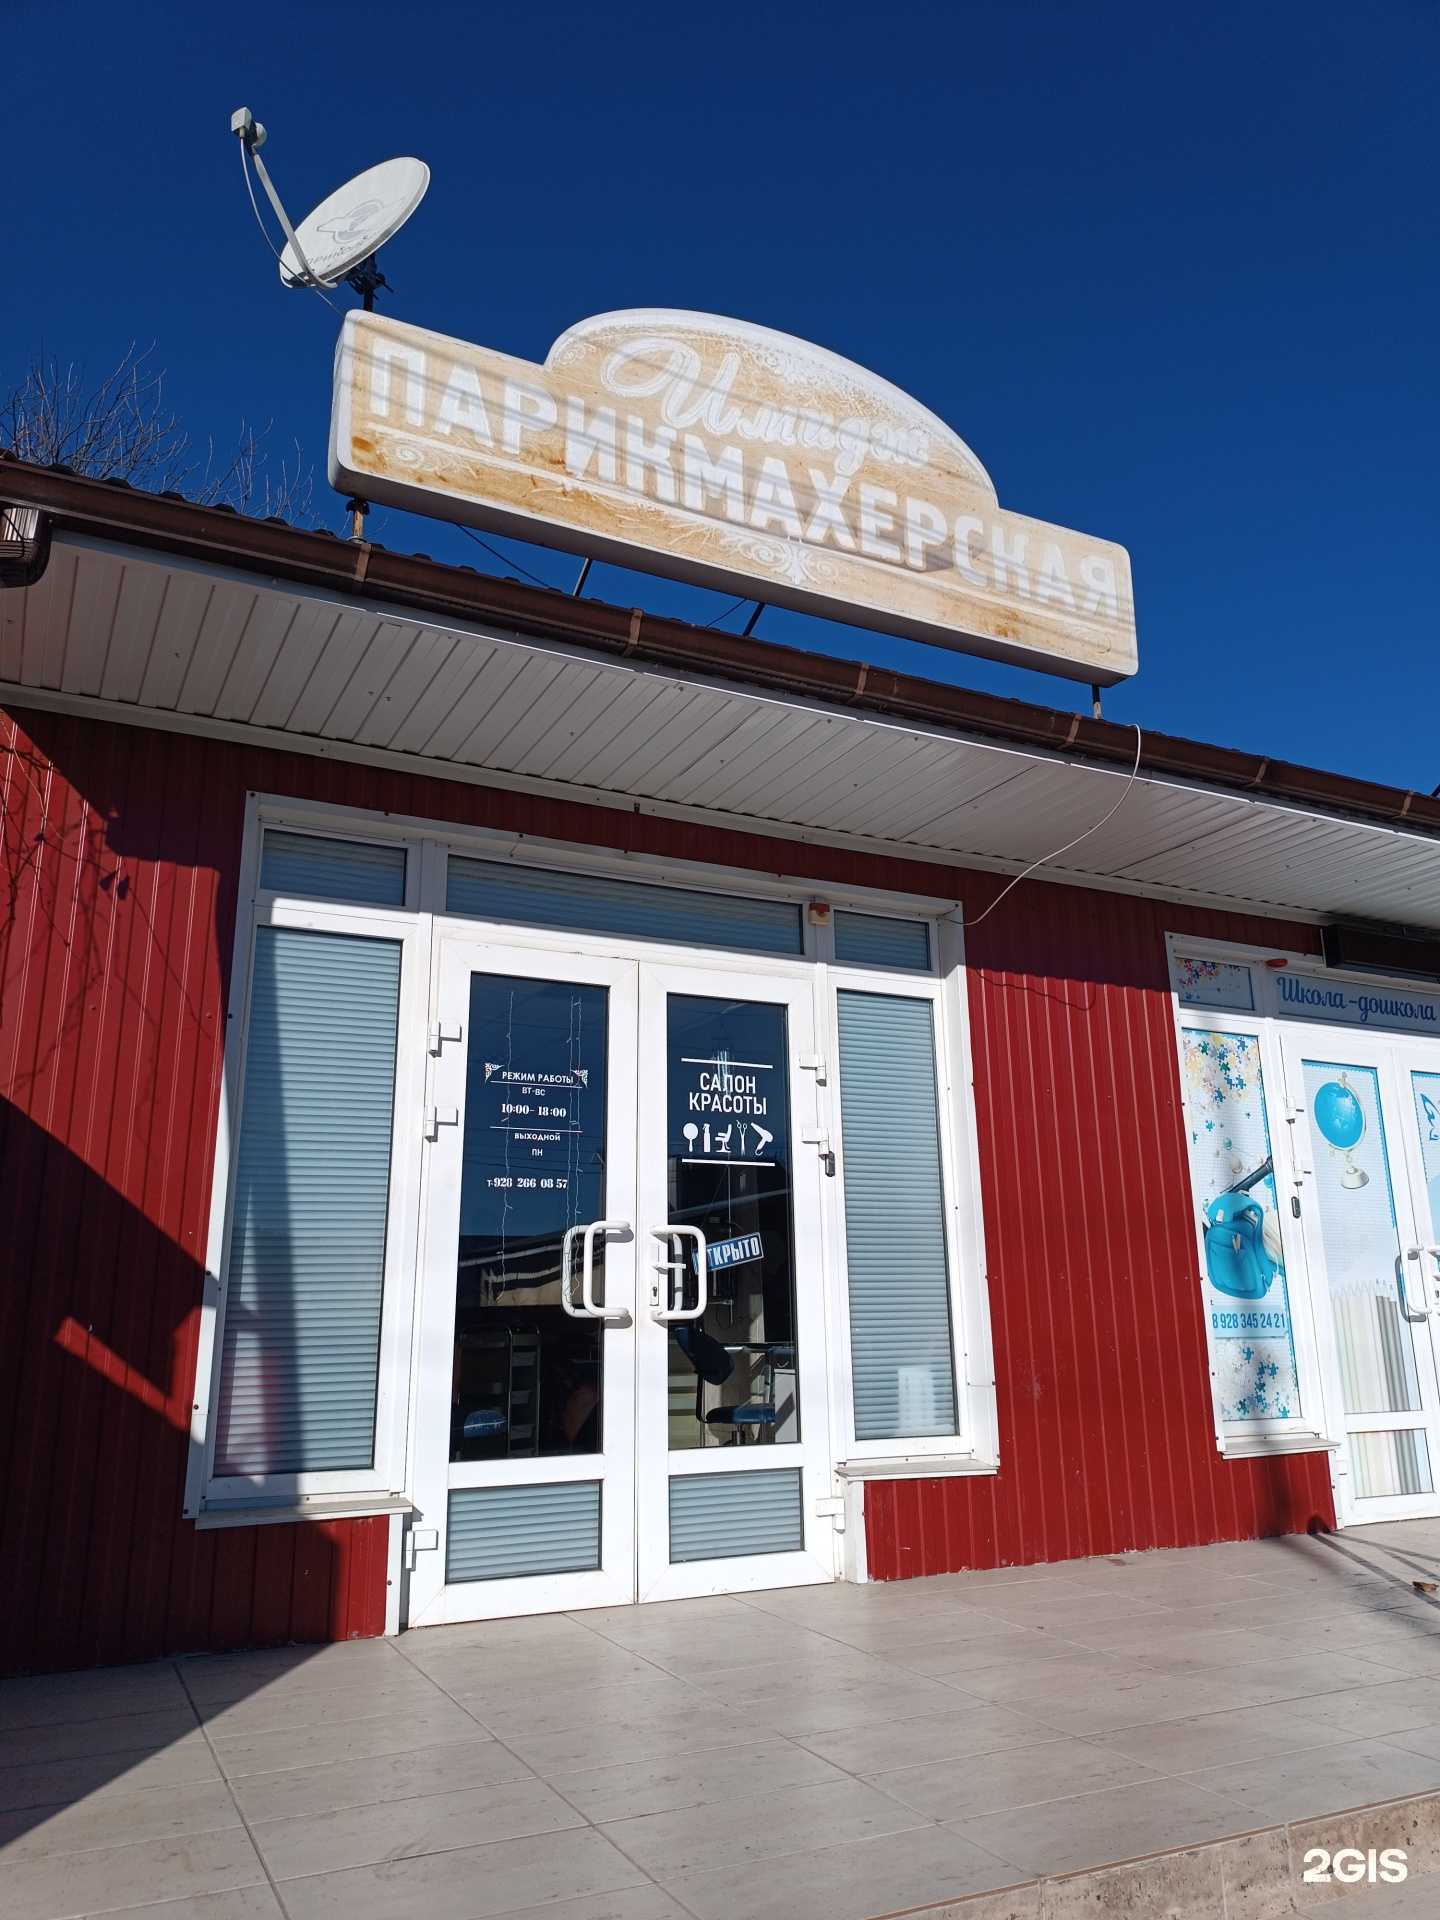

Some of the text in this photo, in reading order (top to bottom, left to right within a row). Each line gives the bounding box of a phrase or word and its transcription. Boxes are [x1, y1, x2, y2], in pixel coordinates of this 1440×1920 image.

[601, 337, 930, 475] Имидж
[368, 336, 1119, 618] ПАРИКМАХЕРСКАЯ
[502, 1071, 574, 1084] РЕЖИМ РАБОТЫ
[700, 1072, 756, 1094] САЛОН
[522, 1086, 546, 1096] ВТ-ВС
[689, 1092, 767, 1115] КРАСОТЫ
[531, 1148, 543, 1157] ПН
[517, 1178, 536, 1188] 266
[540, 1179, 553, 1189] 08
[556, 1180, 568, 1189] 57
[1212, 1313, 1285, 1329] 8 928 345 24 21
